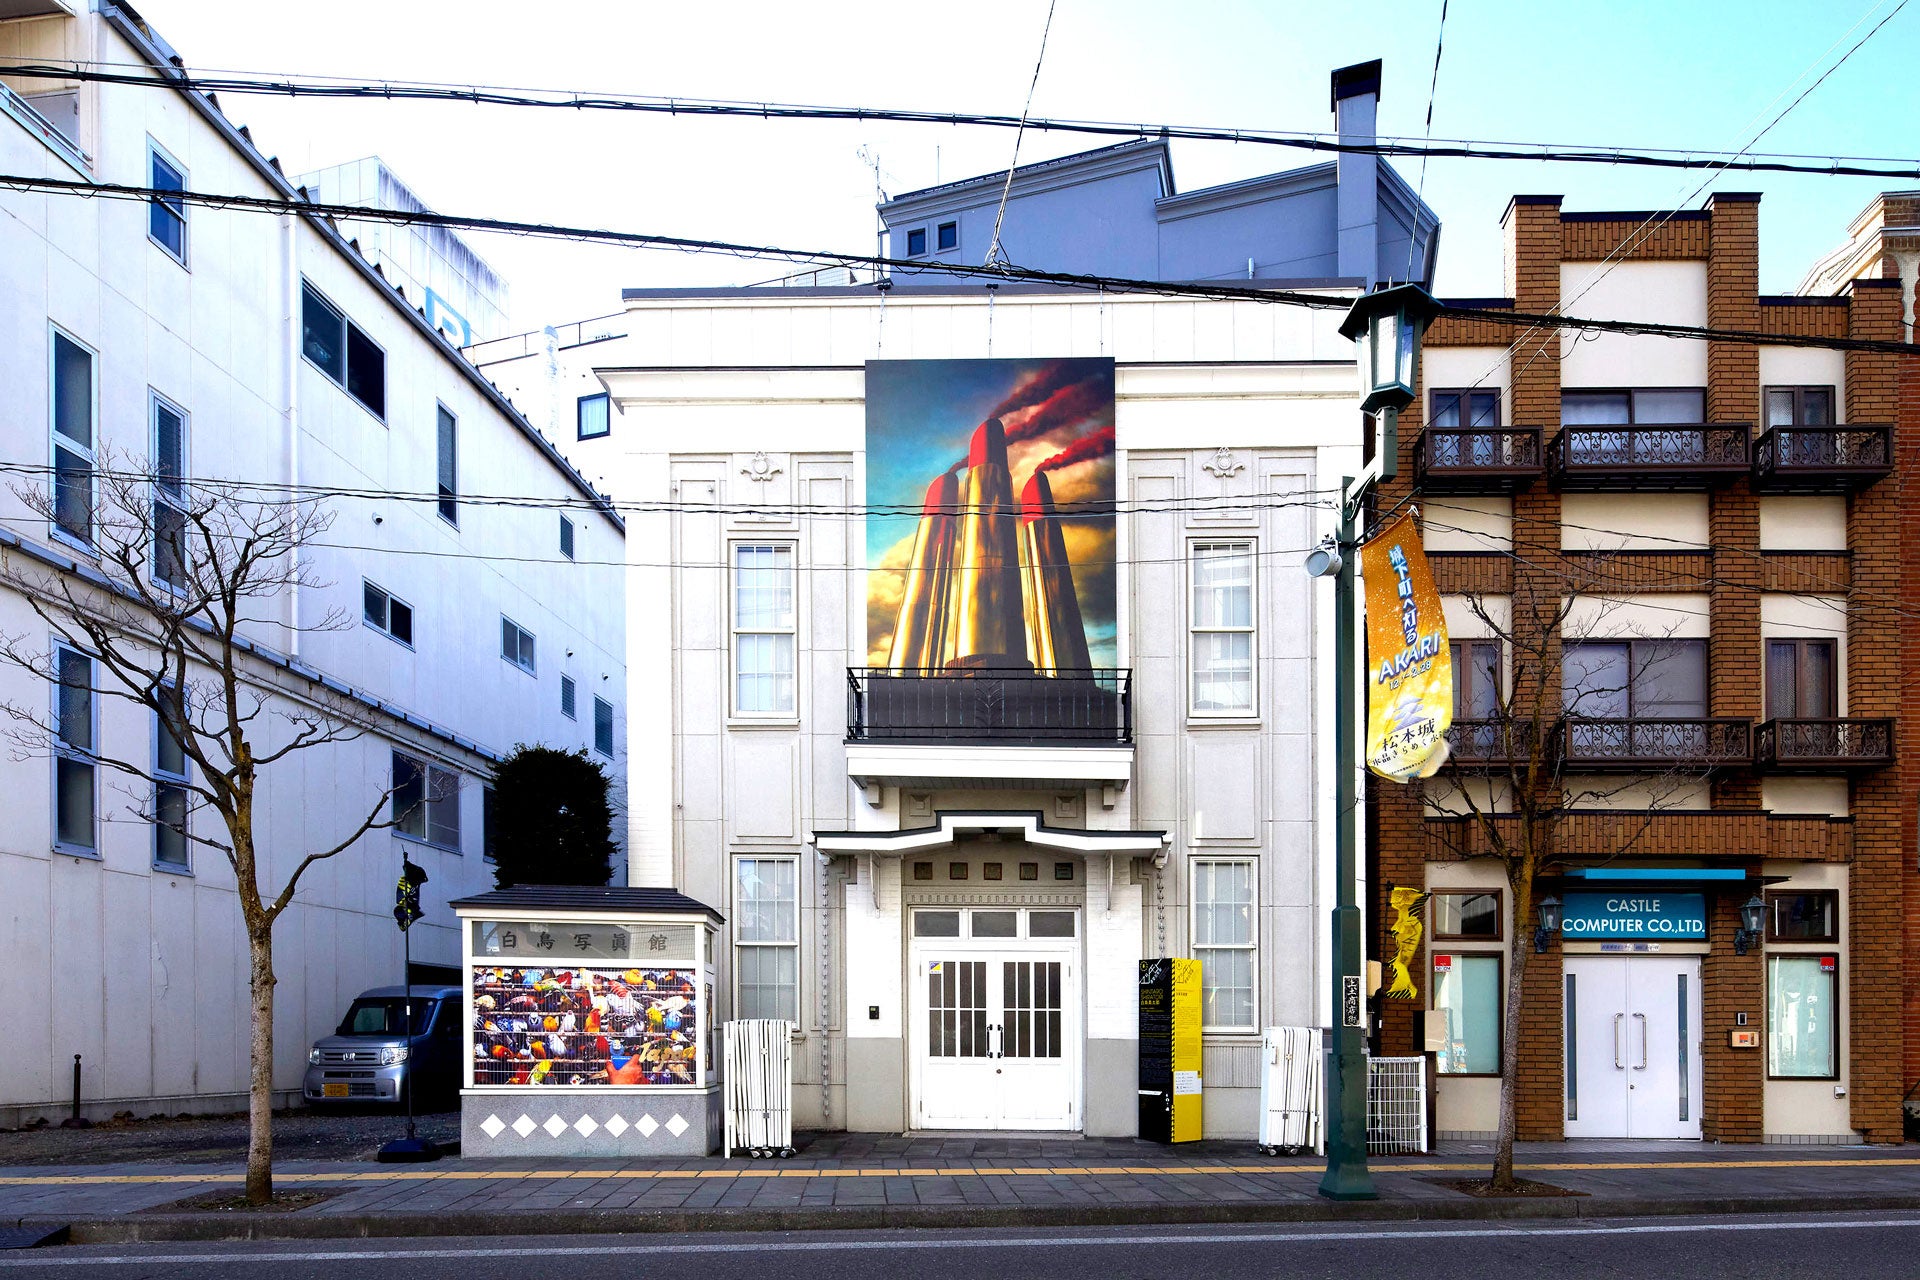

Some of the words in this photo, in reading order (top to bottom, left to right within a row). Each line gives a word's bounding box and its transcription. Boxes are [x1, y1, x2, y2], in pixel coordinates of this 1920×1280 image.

[1389, 544, 1418, 646] 城下町へ灯る
[1379, 632, 1440, 684] AKARI
[1382, 718, 1435, 751] 松本城
[1606, 899, 1661, 912] CASTLE
[1562, 918, 1643, 932] COMPUTER
[1647, 918, 1706, 933] CO.,LTD.
